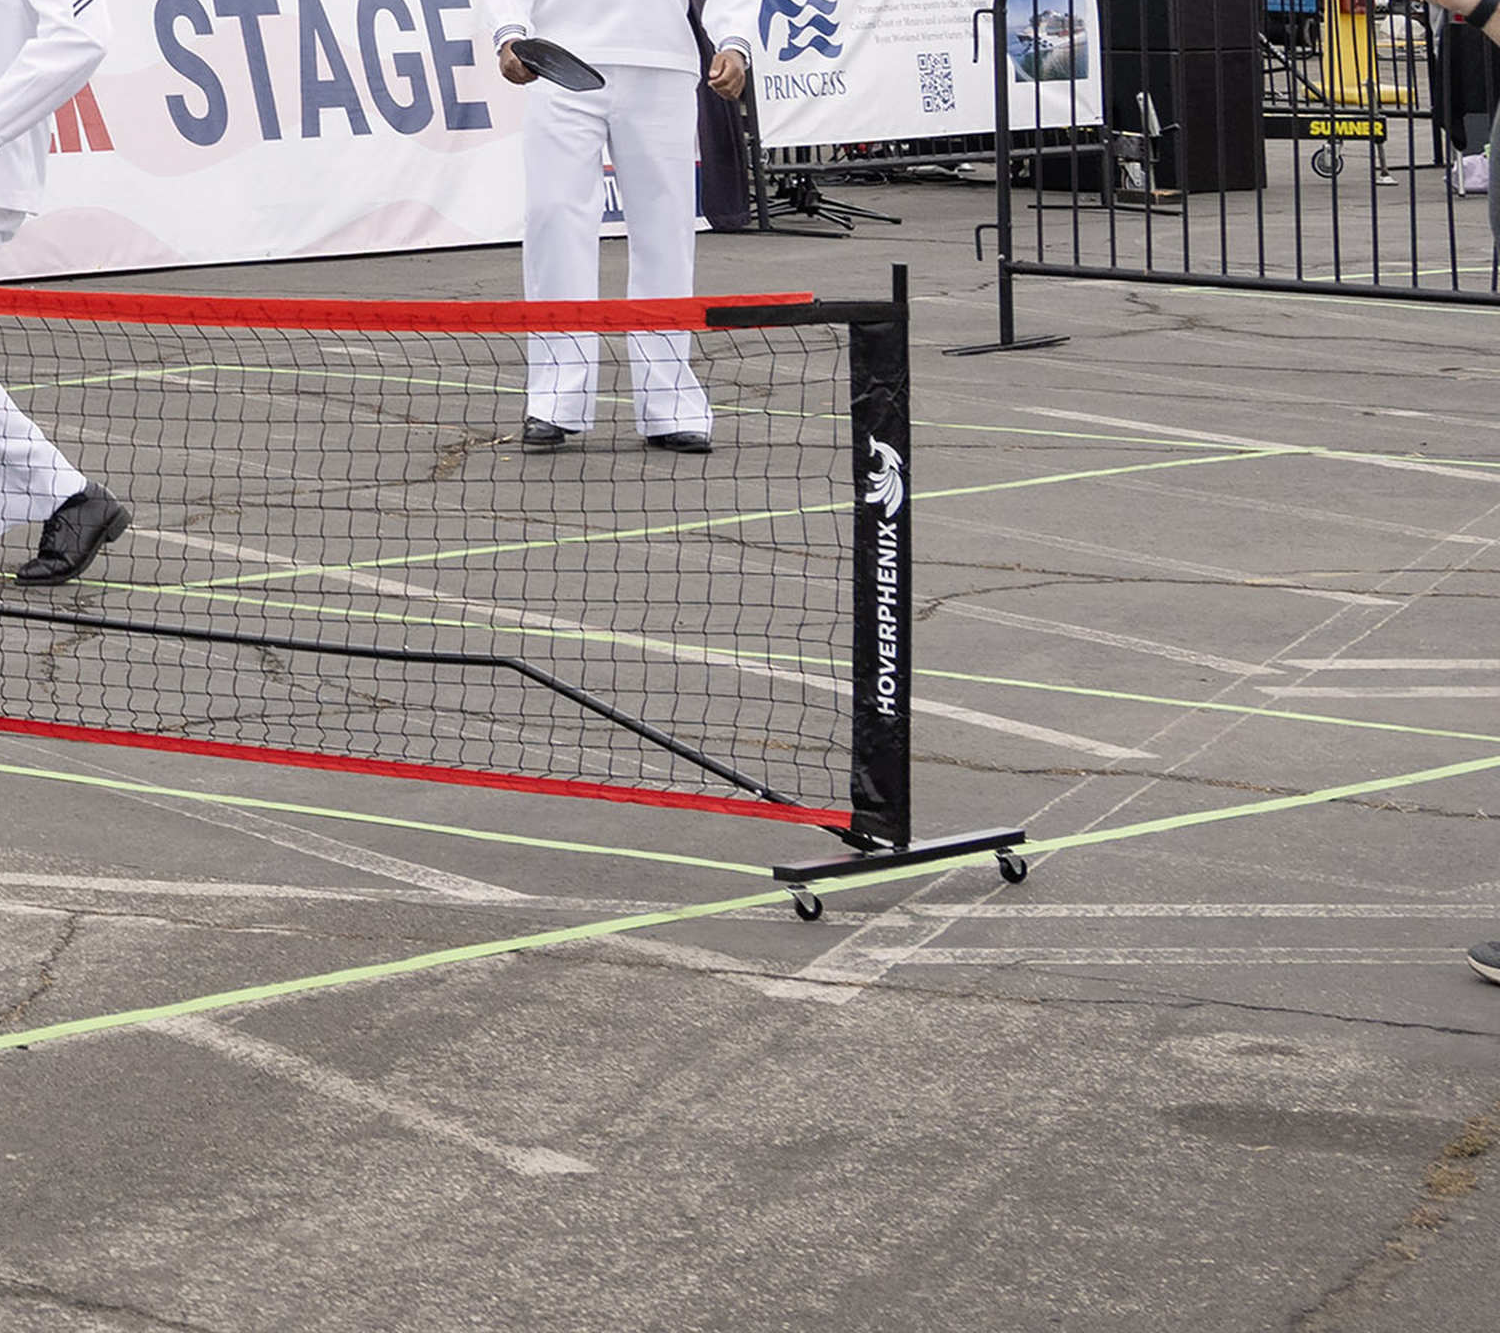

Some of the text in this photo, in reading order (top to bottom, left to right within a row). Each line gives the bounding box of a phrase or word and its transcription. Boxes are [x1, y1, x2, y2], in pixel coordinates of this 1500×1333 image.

[764, 69, 847, 101] PRINCESS
[1310, 121, 1383, 136] SUMNER
[876, 521, 898, 718] HOVERPHENIX
